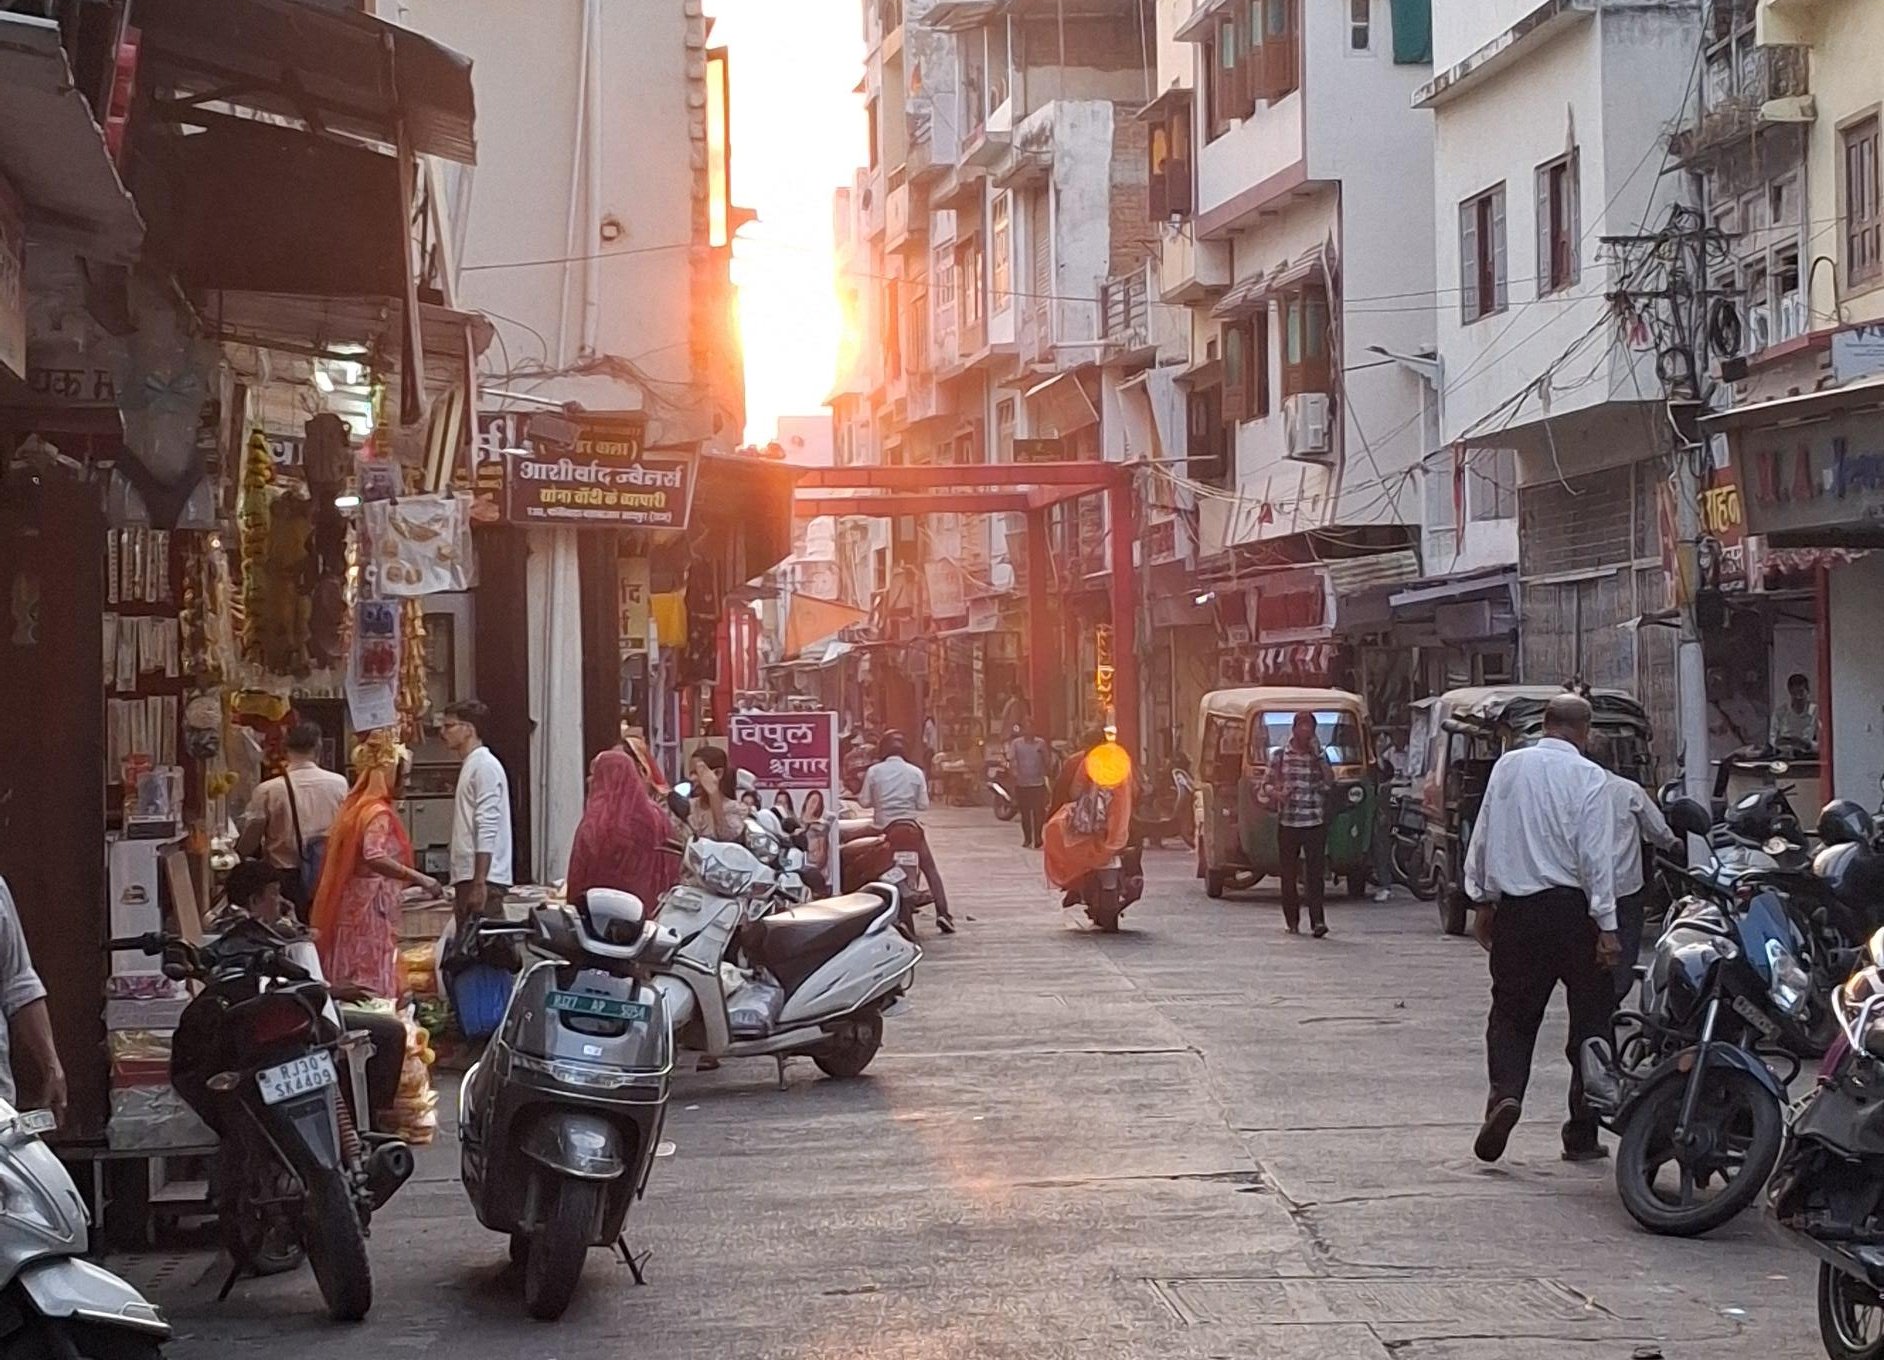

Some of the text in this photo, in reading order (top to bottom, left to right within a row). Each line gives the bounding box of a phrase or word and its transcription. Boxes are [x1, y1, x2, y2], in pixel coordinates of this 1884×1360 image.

[520, 458, 611, 485] आशीर्वाद
[615, 462, 682, 488] ज्वेलर्स
[604, 489, 618, 506] के
[728, 716, 816, 752] विपुल
